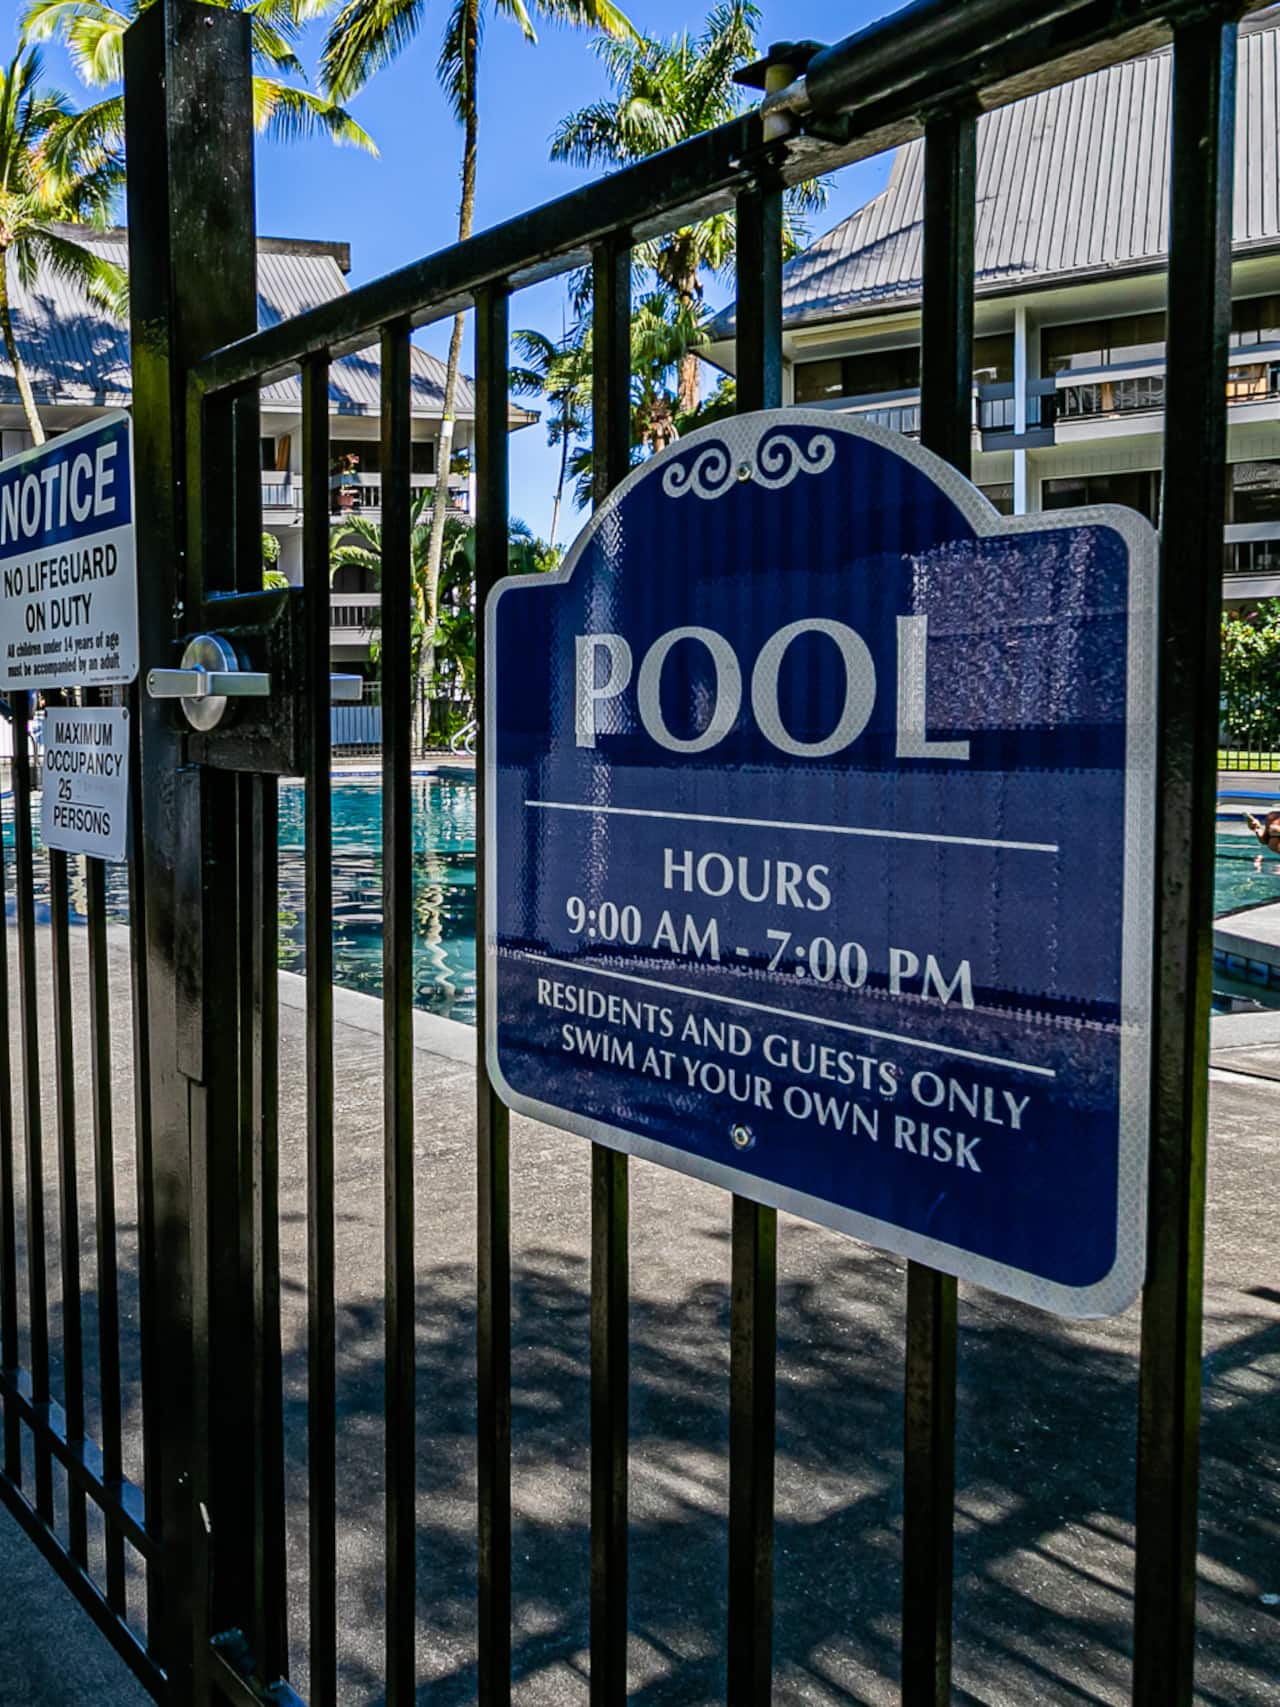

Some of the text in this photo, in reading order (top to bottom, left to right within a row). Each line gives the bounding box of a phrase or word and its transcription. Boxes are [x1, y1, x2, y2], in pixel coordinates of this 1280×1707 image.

[0, 440, 118, 545] NOTICE
[4, 543, 117, 598] NO LIFEGUARD
[25, 592, 92, 633] ON DUTY
[8, 662, 22, 677] must
[24, 661, 31, 676] be
[33, 656, 76, 677] accompanied
[78, 656, 87, 675] by
[89, 658, 98, 670] an
[17, 641, 41, 657] children
[43, 638, 62, 654] under
[64, 635, 73, 652] 14
[75, 636, 94, 654] years
[96, 631, 104, 649] of
[106, 632, 119, 651] age
[574, 613, 971, 761] POOL
[55, 721, 113, 746] MAXIMUM
[47, 749, 122, 777] OCCUPANCY
[58, 777, 72, 800] 25
[54, 805, 110, 836] PERSONS
[663, 847, 831, 911] HOURS
[566, 896, 642, 945] 9:00
[652, 909, 721, 961] AM
[765, 928, 868, 988] 7:00
[888, 947, 975, 1010] PM
[537, 978, 1030, 1130] RESIDENTS AND GUESTS ONLY
[562, 1024, 982, 1172] SWIM AT YOUR OWN RISK
